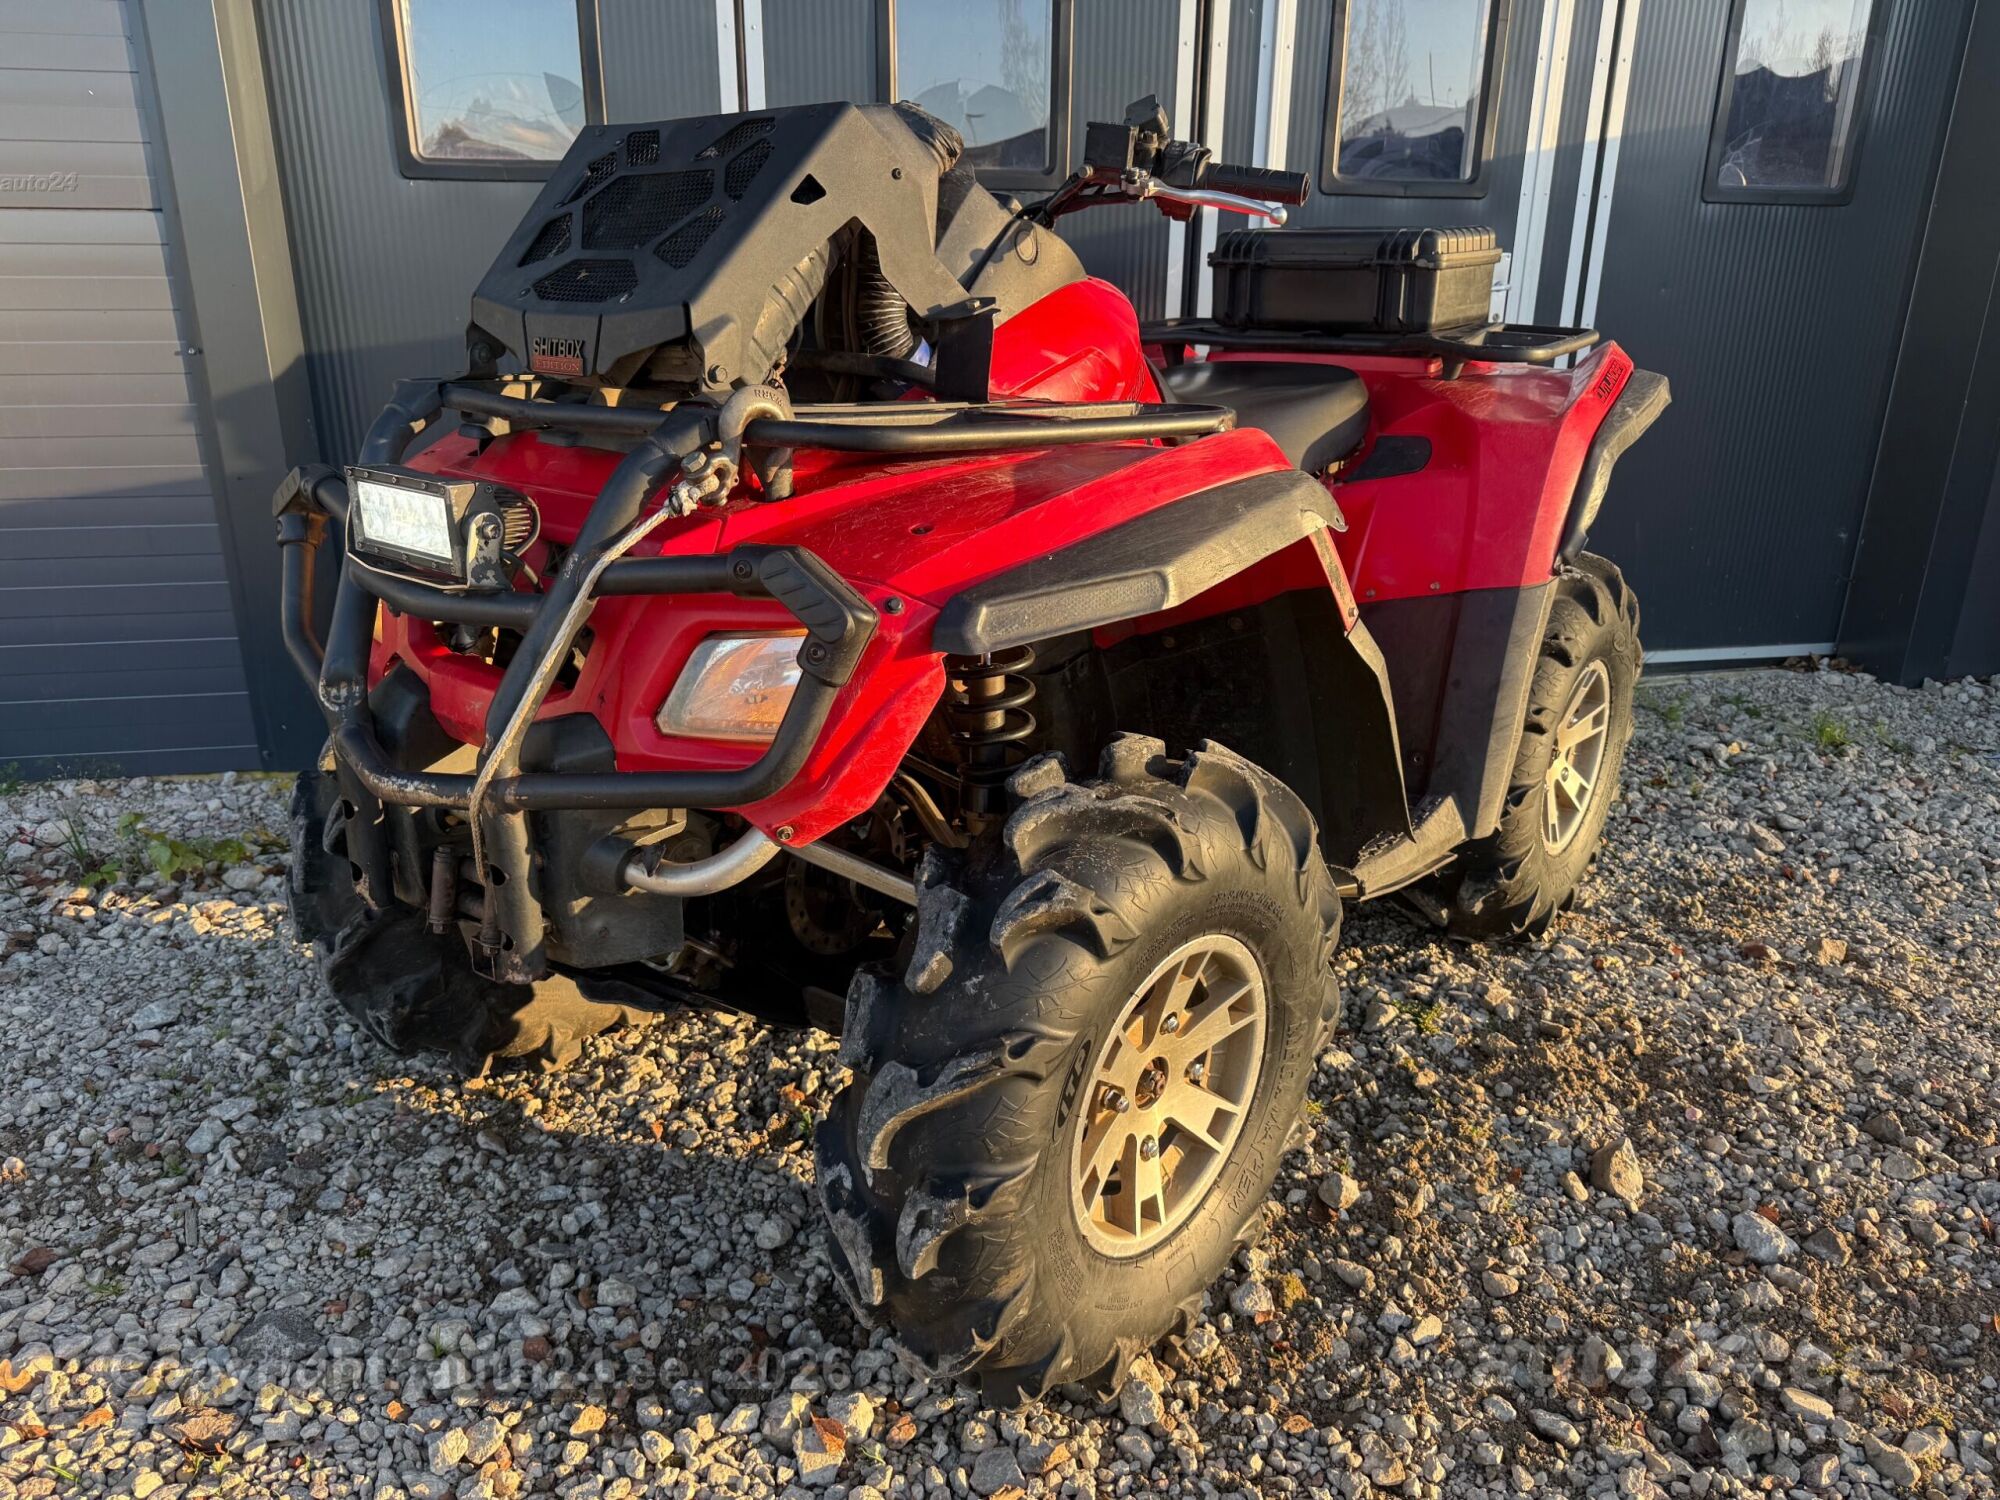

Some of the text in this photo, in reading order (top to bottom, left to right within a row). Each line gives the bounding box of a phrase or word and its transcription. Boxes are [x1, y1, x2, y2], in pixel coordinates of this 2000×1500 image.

[533, 337, 583, 358] SHITBOX
[536, 359, 579, 371] EDITION
[1060, 1047, 1087, 1118] ITP
